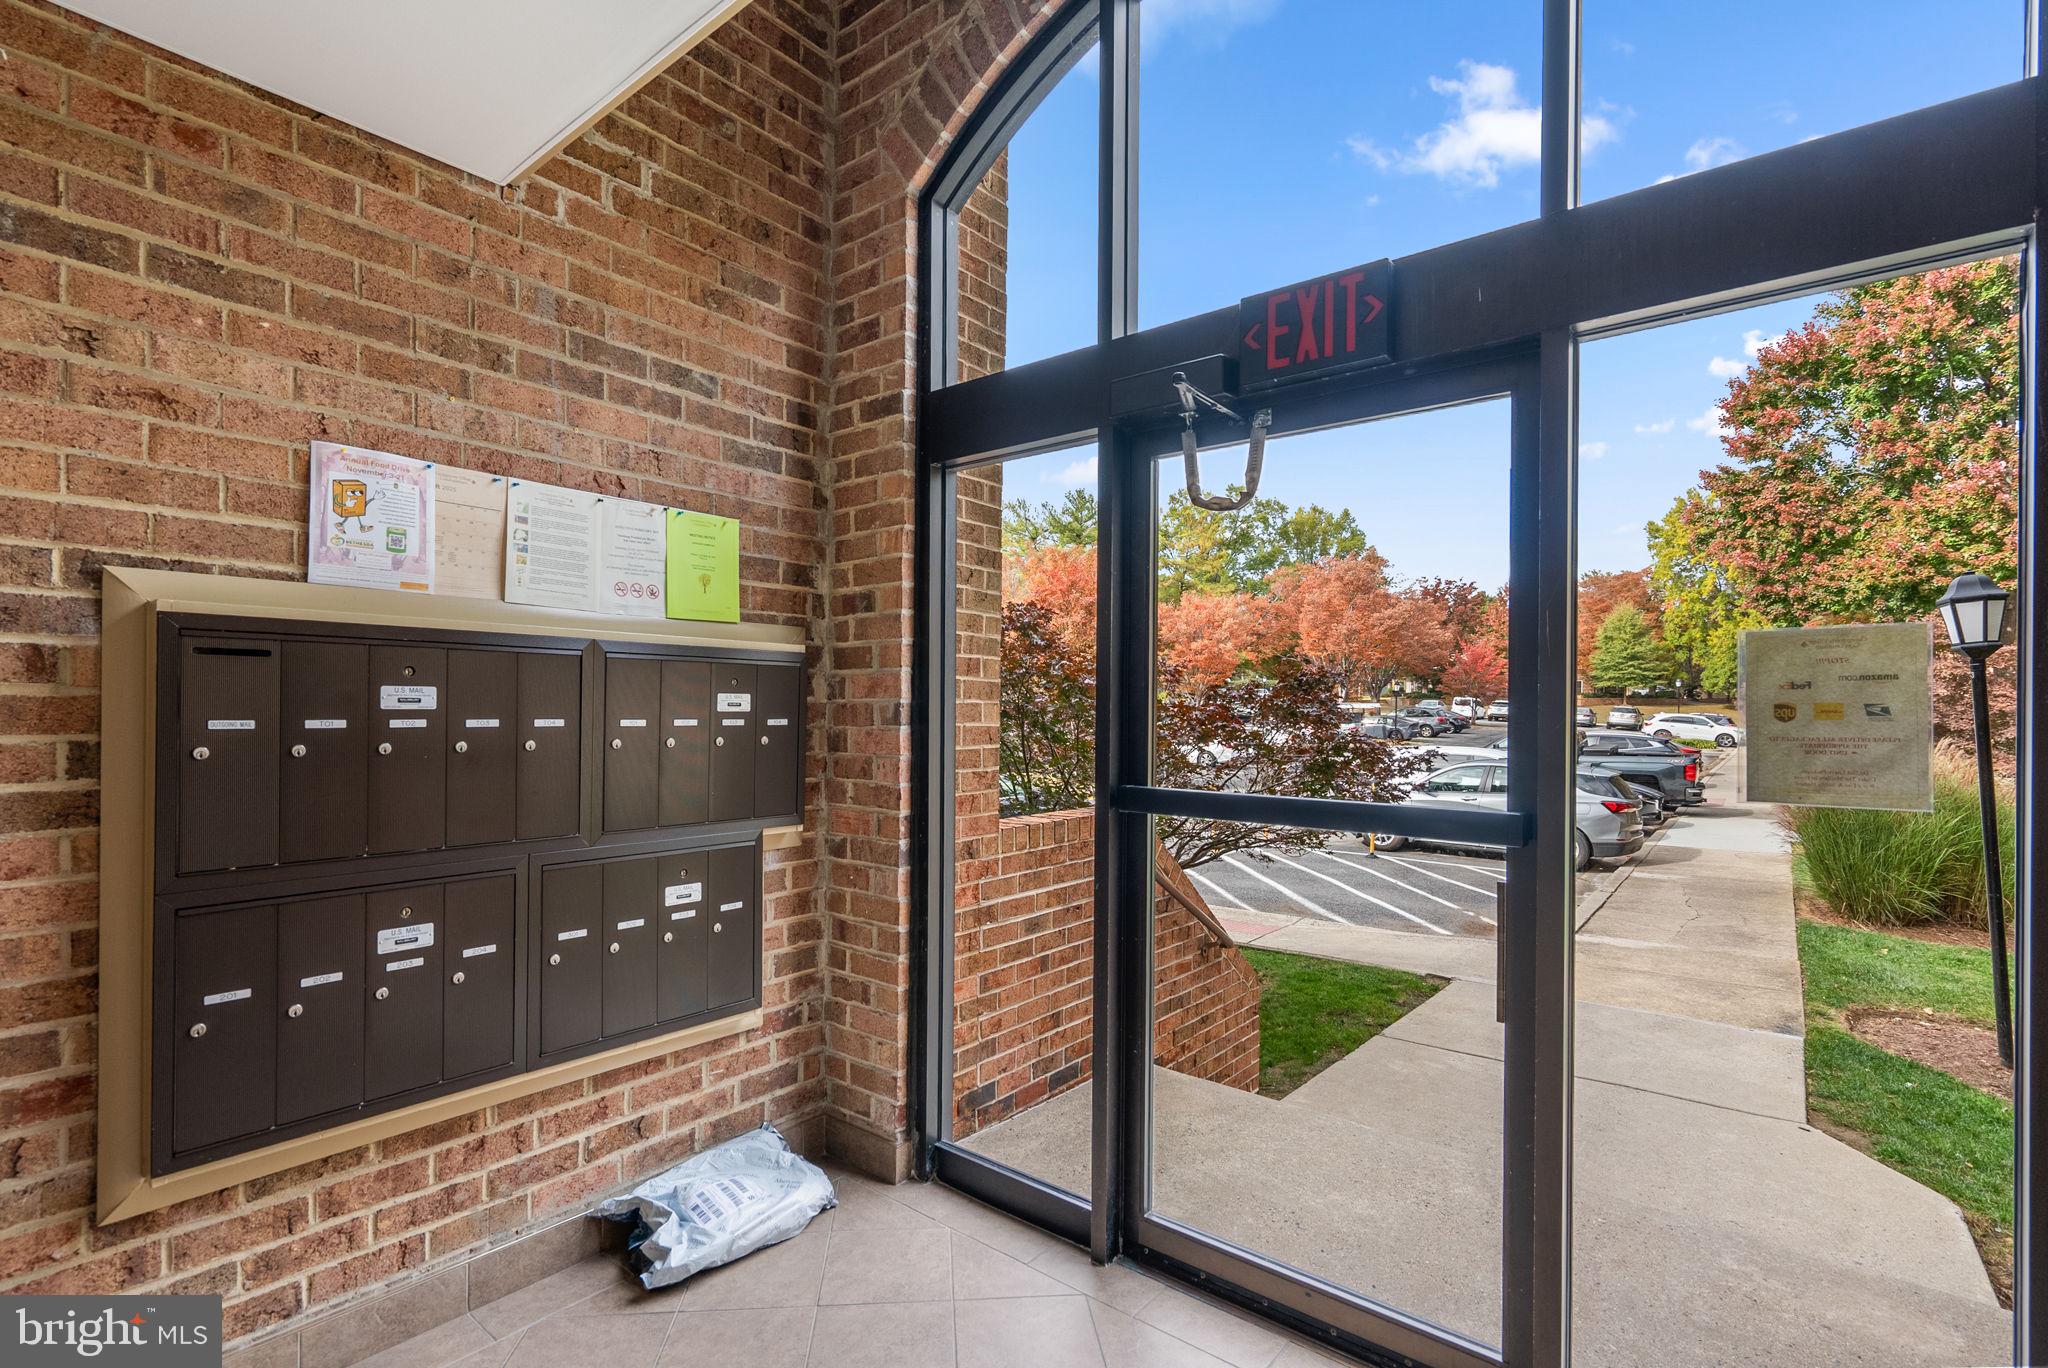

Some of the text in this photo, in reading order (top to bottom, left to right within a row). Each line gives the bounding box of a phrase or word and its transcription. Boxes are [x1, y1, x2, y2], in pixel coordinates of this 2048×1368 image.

[1266, 272, 1365, 370] EXIT
[340, 455, 410, 474] Annual Food Drive
[346, 465, 387, 478] November
[405, 926, 422, 934] MAIL
[396, 960, 414, 968] 203
[312, 975, 332, 983] 202
[219, 992, 238, 1001] 201
